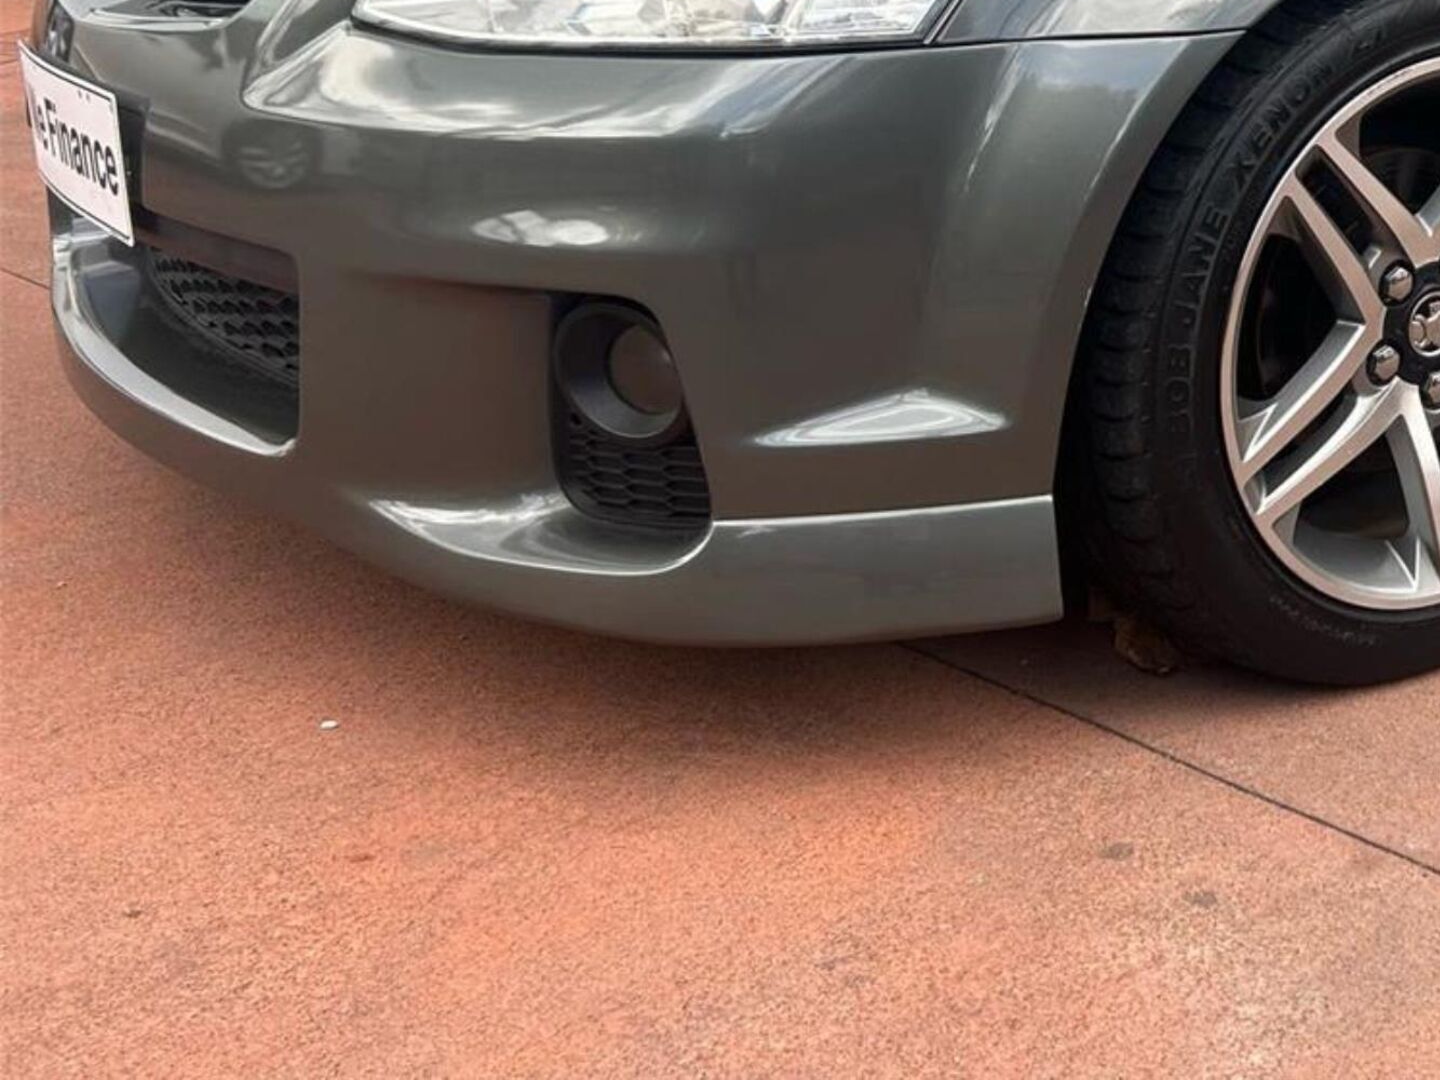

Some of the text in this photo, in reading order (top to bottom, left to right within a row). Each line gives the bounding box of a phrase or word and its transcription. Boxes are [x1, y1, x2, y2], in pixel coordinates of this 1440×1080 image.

[44, 96, 120, 197] Finance
[1170, 201, 1234, 334] JANE
[1226, 58, 1335, 190] XENON
